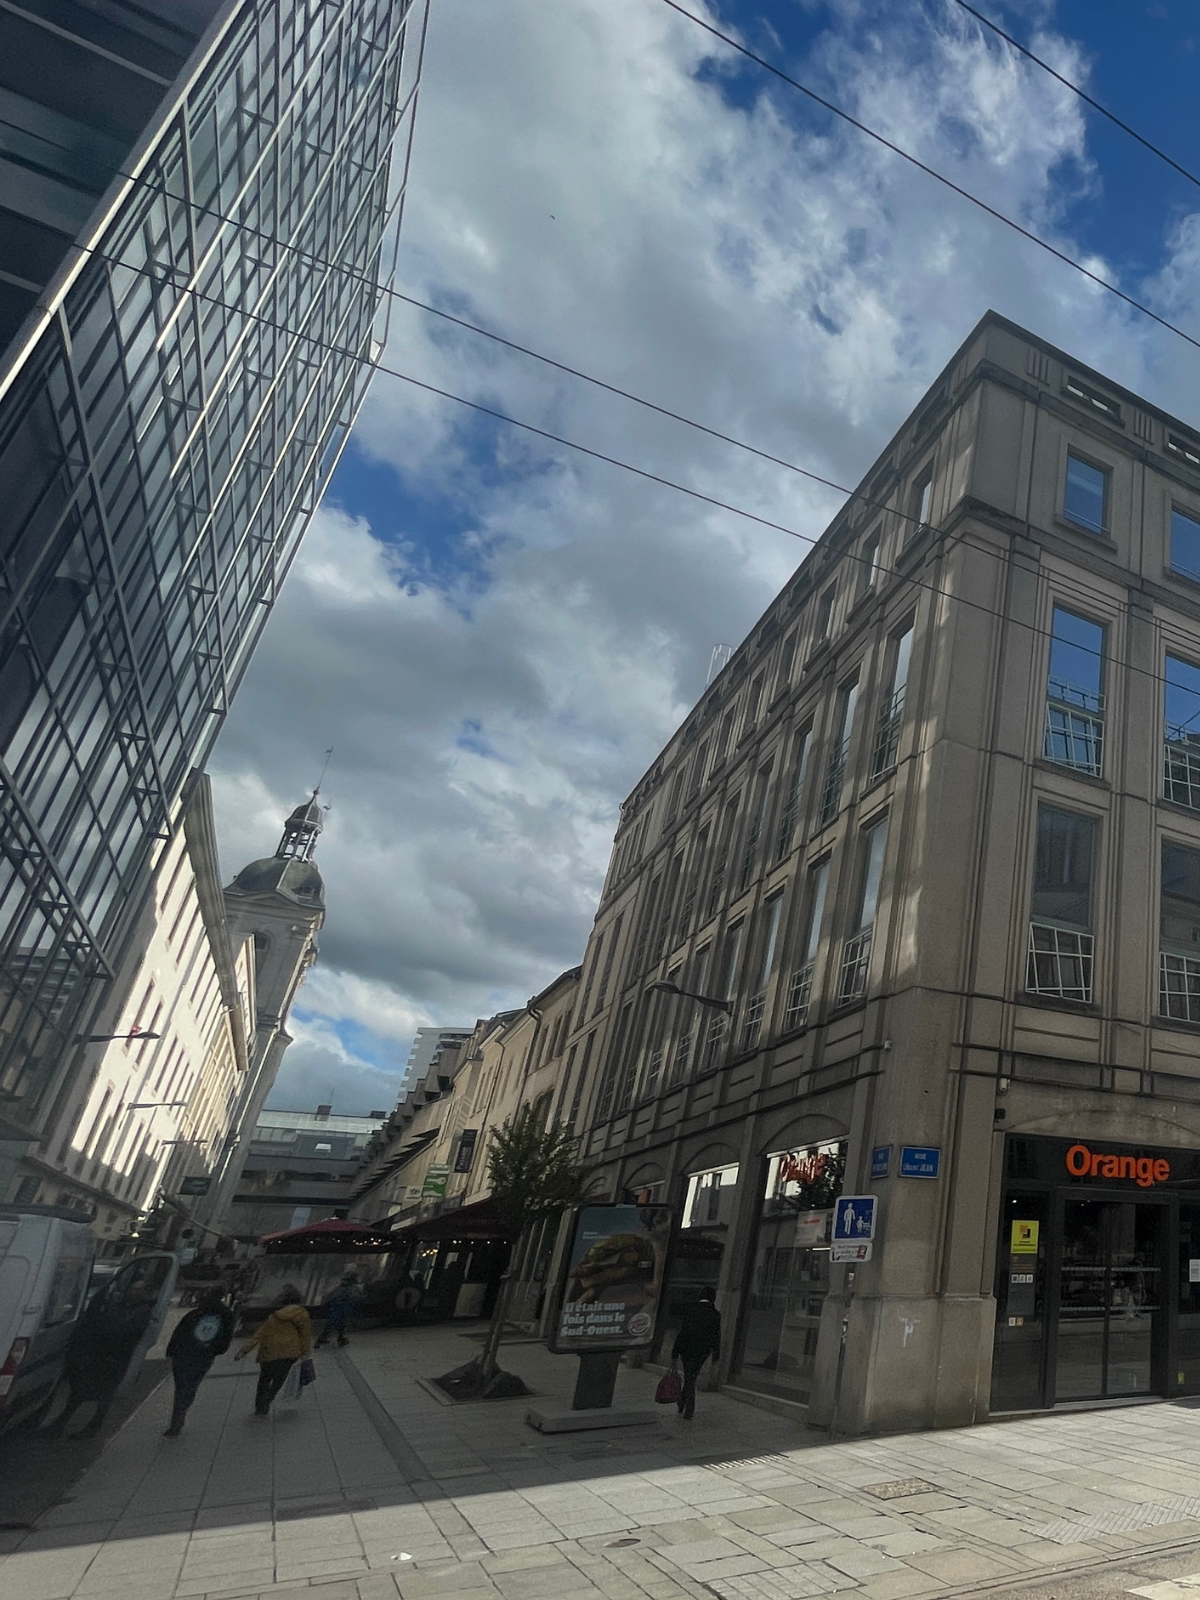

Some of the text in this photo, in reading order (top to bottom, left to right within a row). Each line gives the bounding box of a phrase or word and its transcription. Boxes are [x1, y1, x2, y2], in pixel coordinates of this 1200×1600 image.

[920, 1164, 933, 1172] JEAN
[1066, 1144, 1170, 1187] Orange
[604, 1302, 626, 1311] une
[562, 1311, 626, 1324] fois dans le
[560, 1325, 624, 1336] Sud-Ouest.
